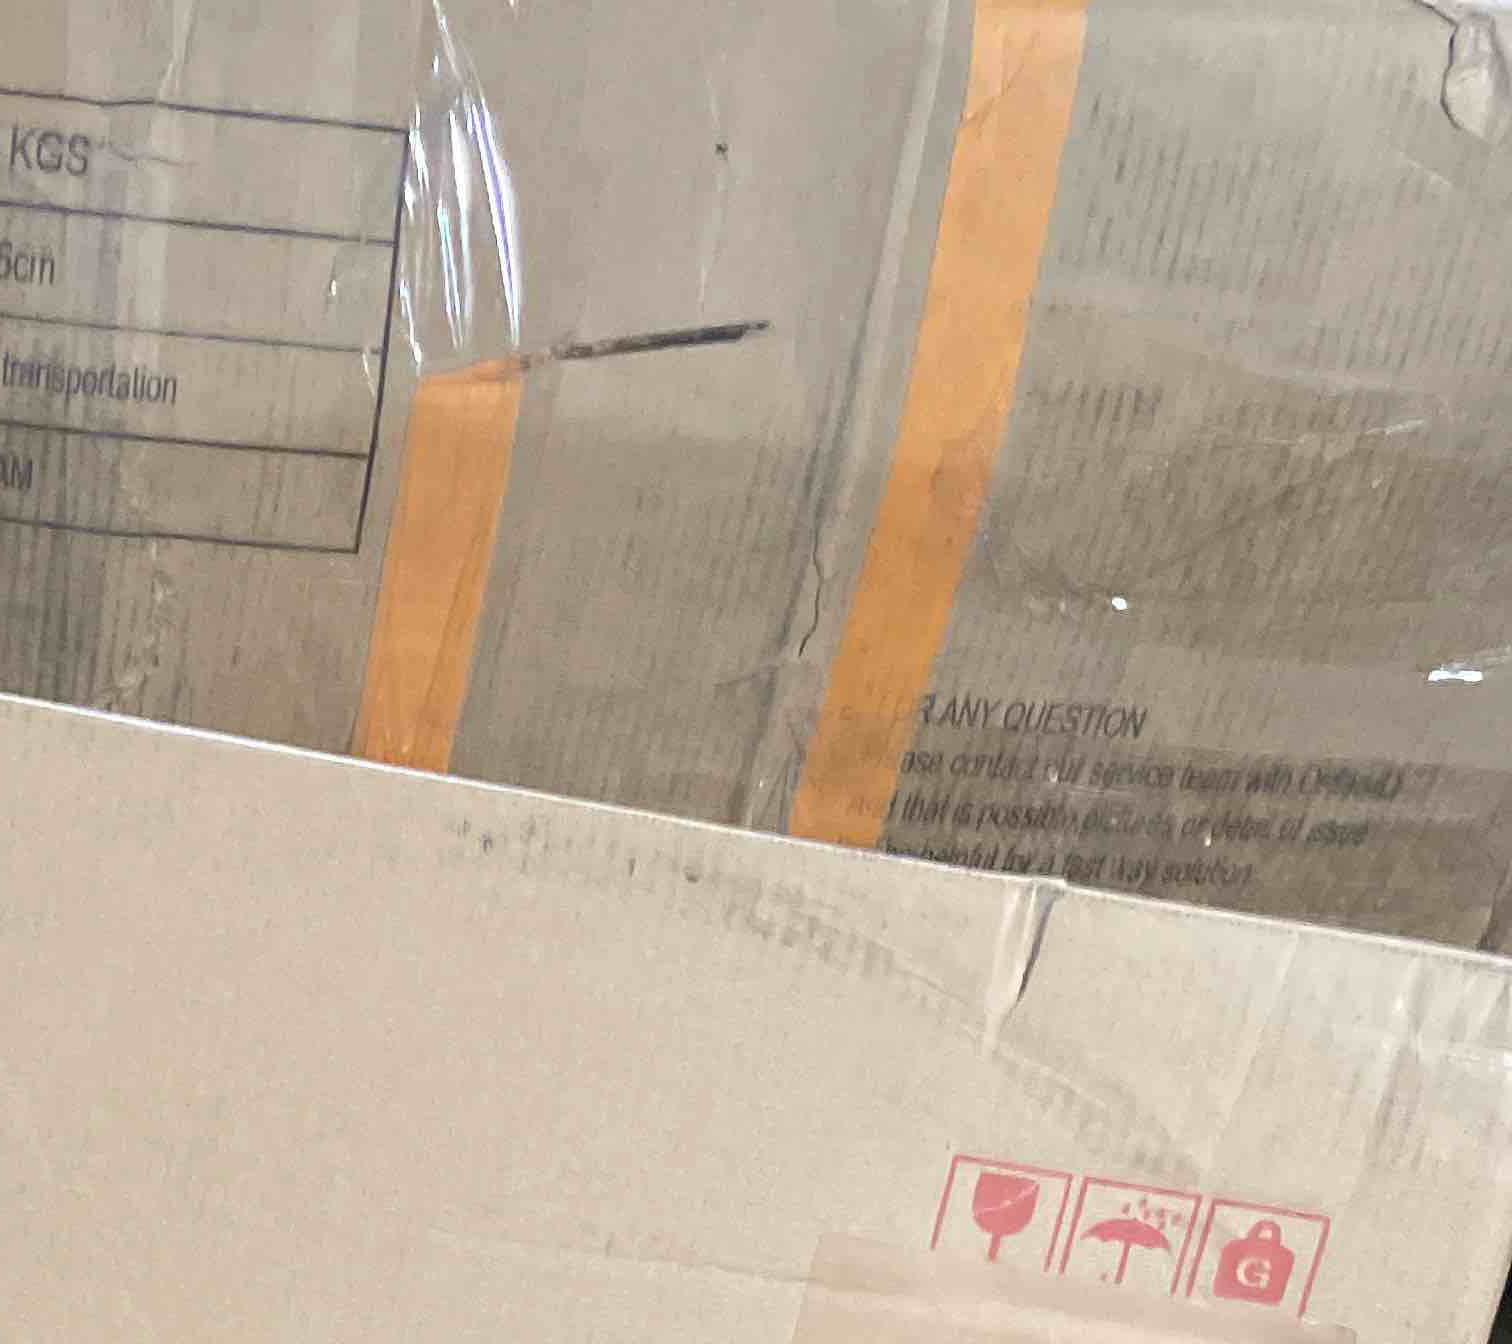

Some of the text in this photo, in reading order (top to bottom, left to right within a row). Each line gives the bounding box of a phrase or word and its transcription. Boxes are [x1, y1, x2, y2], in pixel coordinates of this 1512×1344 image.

[10, 121, 90, 176] KGS
[1, 350, 179, 407] transportation
[938, 695, 1001, 731] ANY
[1002, 699, 1149, 740] QUESTION
